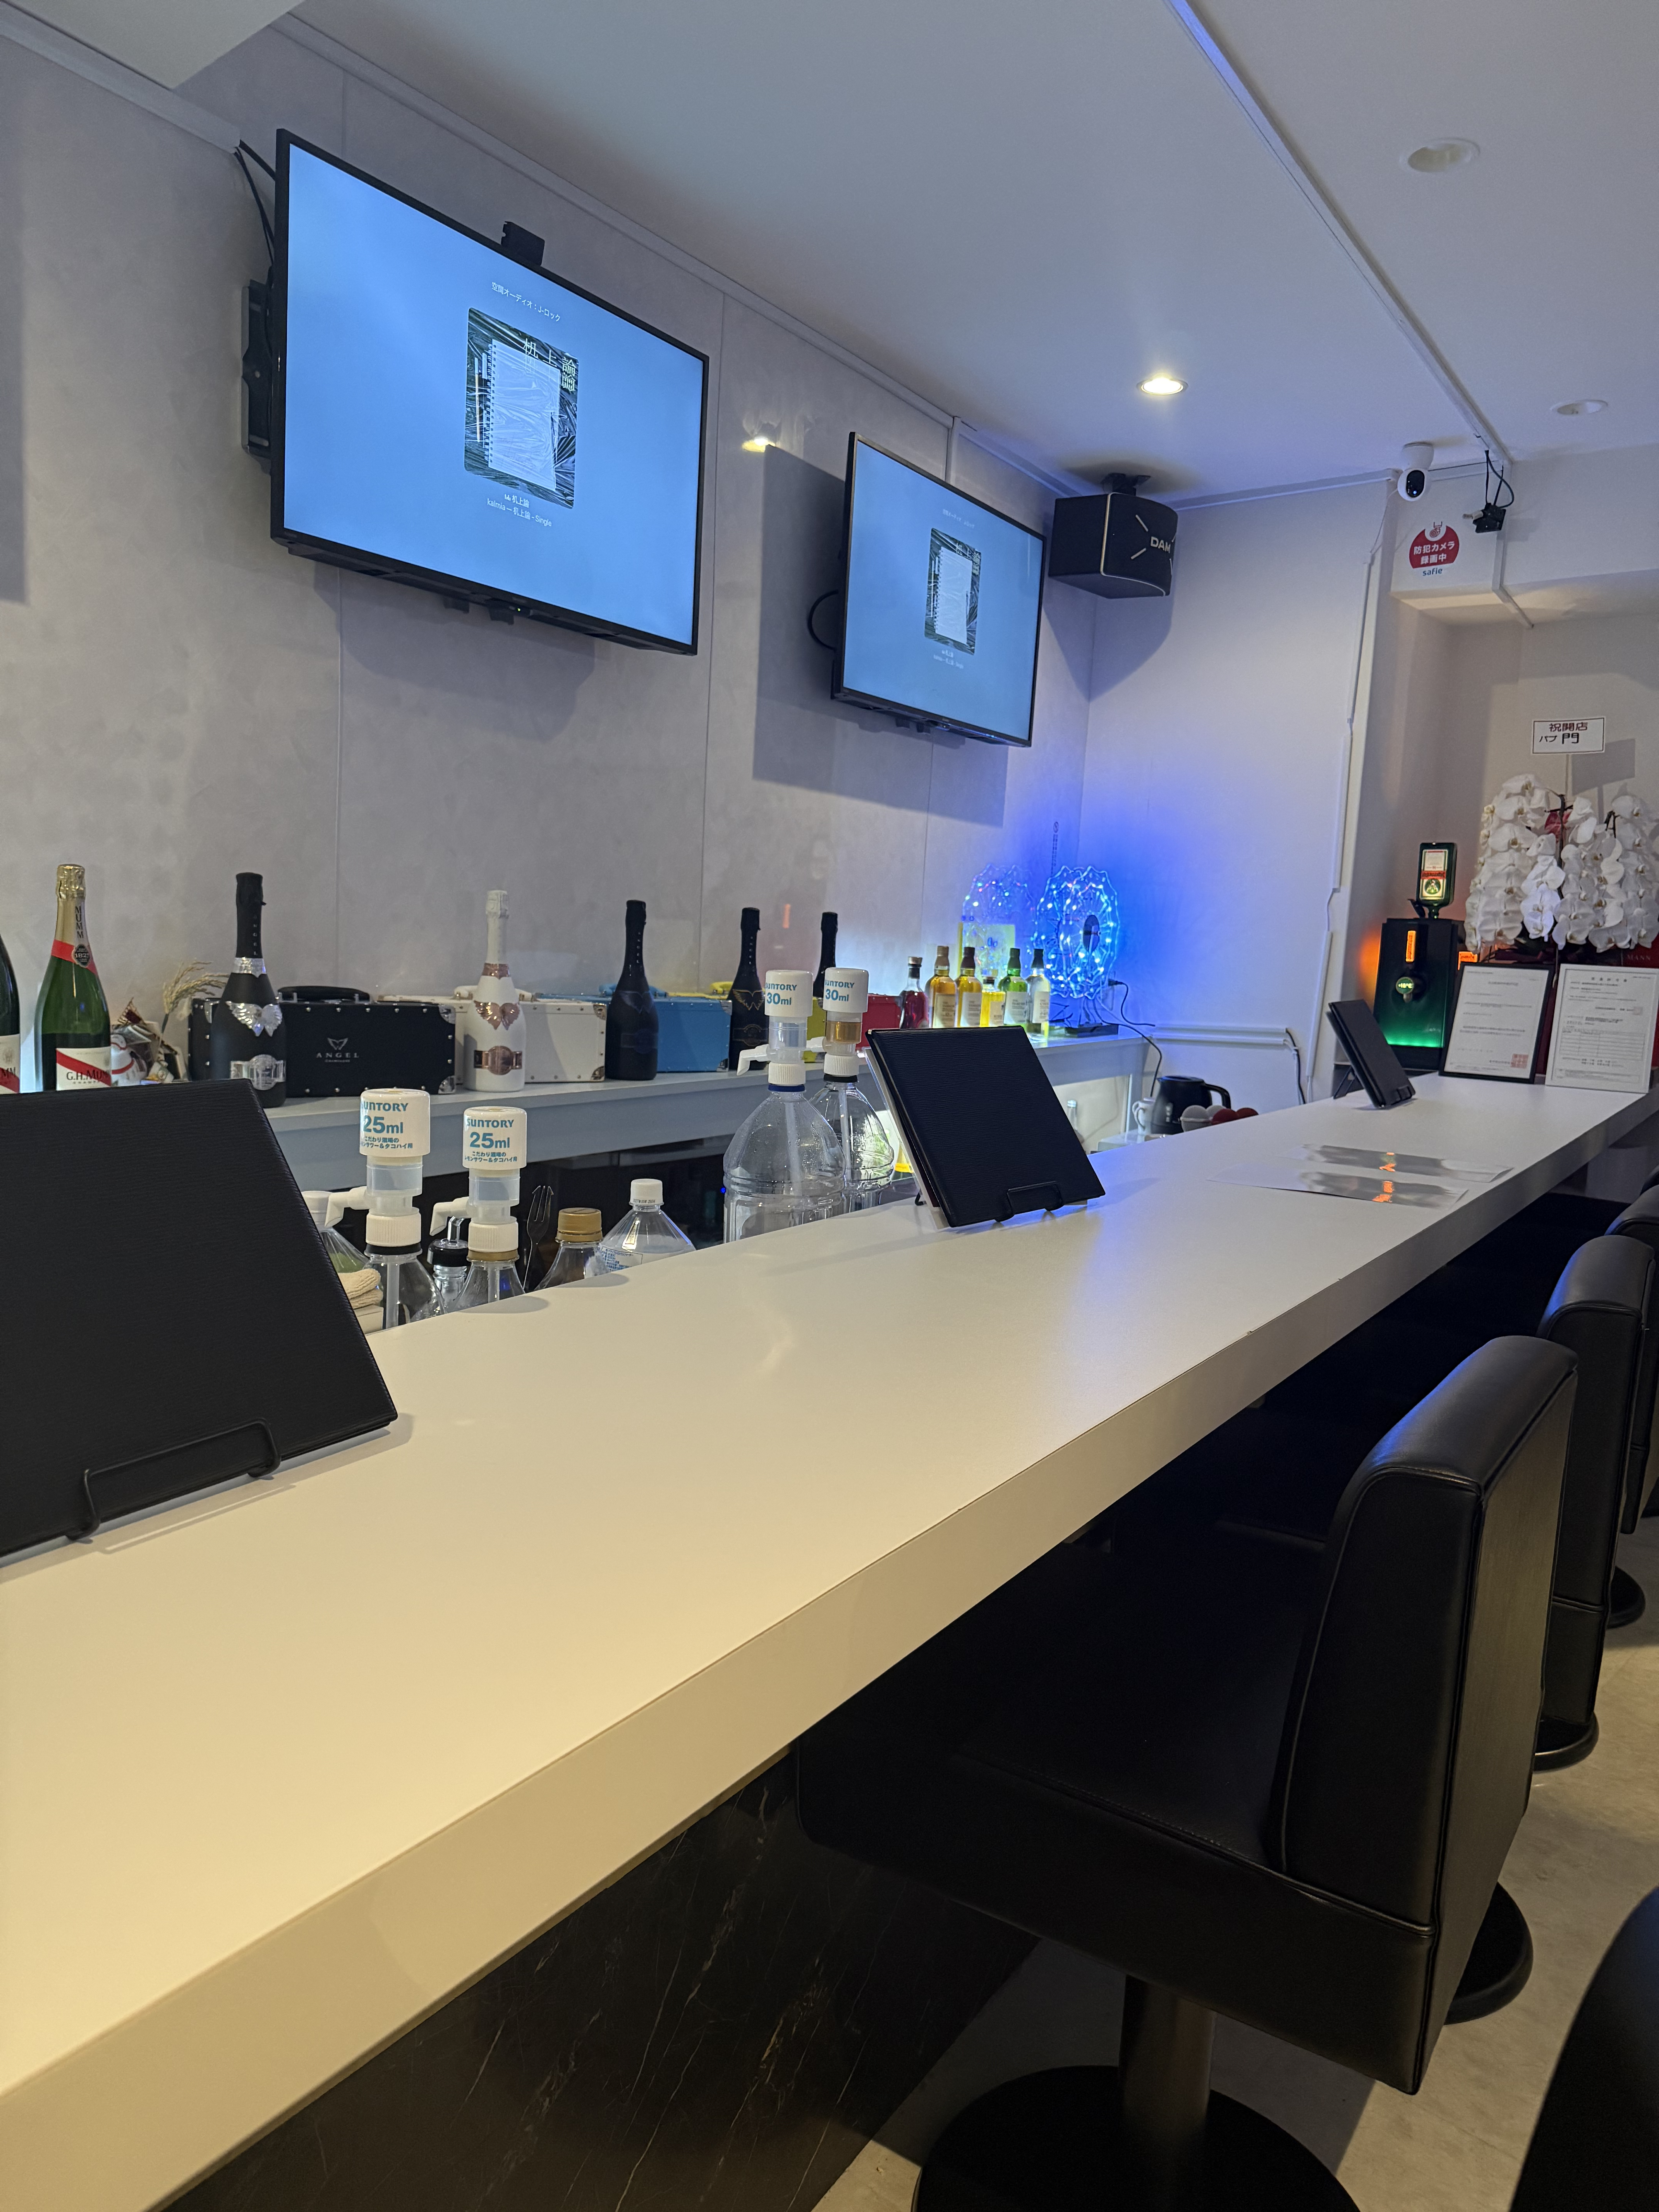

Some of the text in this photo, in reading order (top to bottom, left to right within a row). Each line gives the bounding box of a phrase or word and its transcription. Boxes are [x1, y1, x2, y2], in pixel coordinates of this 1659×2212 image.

[487, 498, 505, 510] kalmia
[535, 515, 552, 527] Single
[1151, 536, 1171, 554] DAM
[1414, 541, 1455, 555] 防犯カメラ
[1549, 722, 1588, 732] 祝開店
[1562, 733, 1579, 744] 門
[75, 905, 84, 938] MUMM
[767, 992, 792, 1005] 30ml
[826, 989, 849, 1001] 30ml
[363, 1115, 403, 1134] 25ml
[470, 1132, 510, 1149] 25ml
